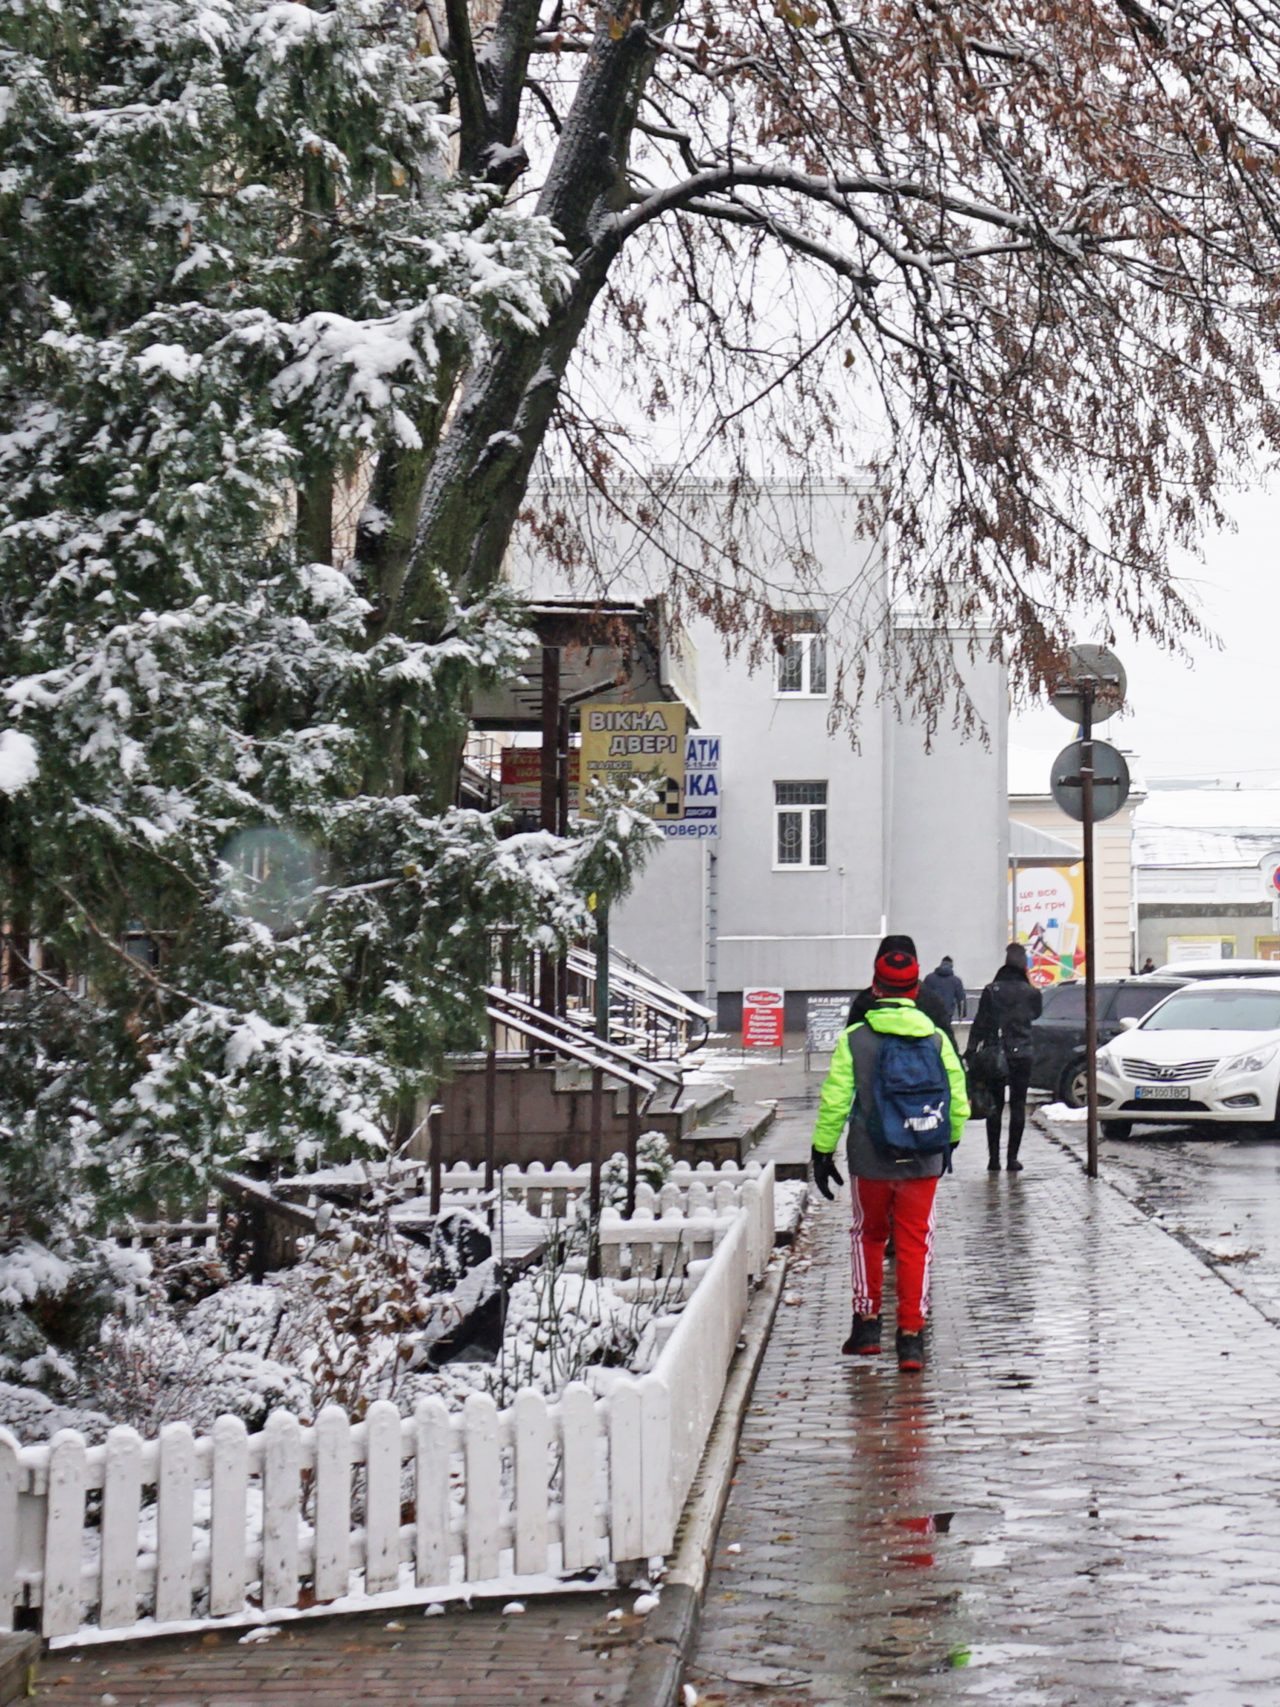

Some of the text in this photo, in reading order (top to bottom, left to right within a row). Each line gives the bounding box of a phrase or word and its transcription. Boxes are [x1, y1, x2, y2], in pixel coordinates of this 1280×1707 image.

[590, 711, 667, 731] ВІКНА
[609, 735, 677, 755] ДВЕРІ
[685, 739, 720, 761] АТИ
[684, 774, 718, 796] КА
